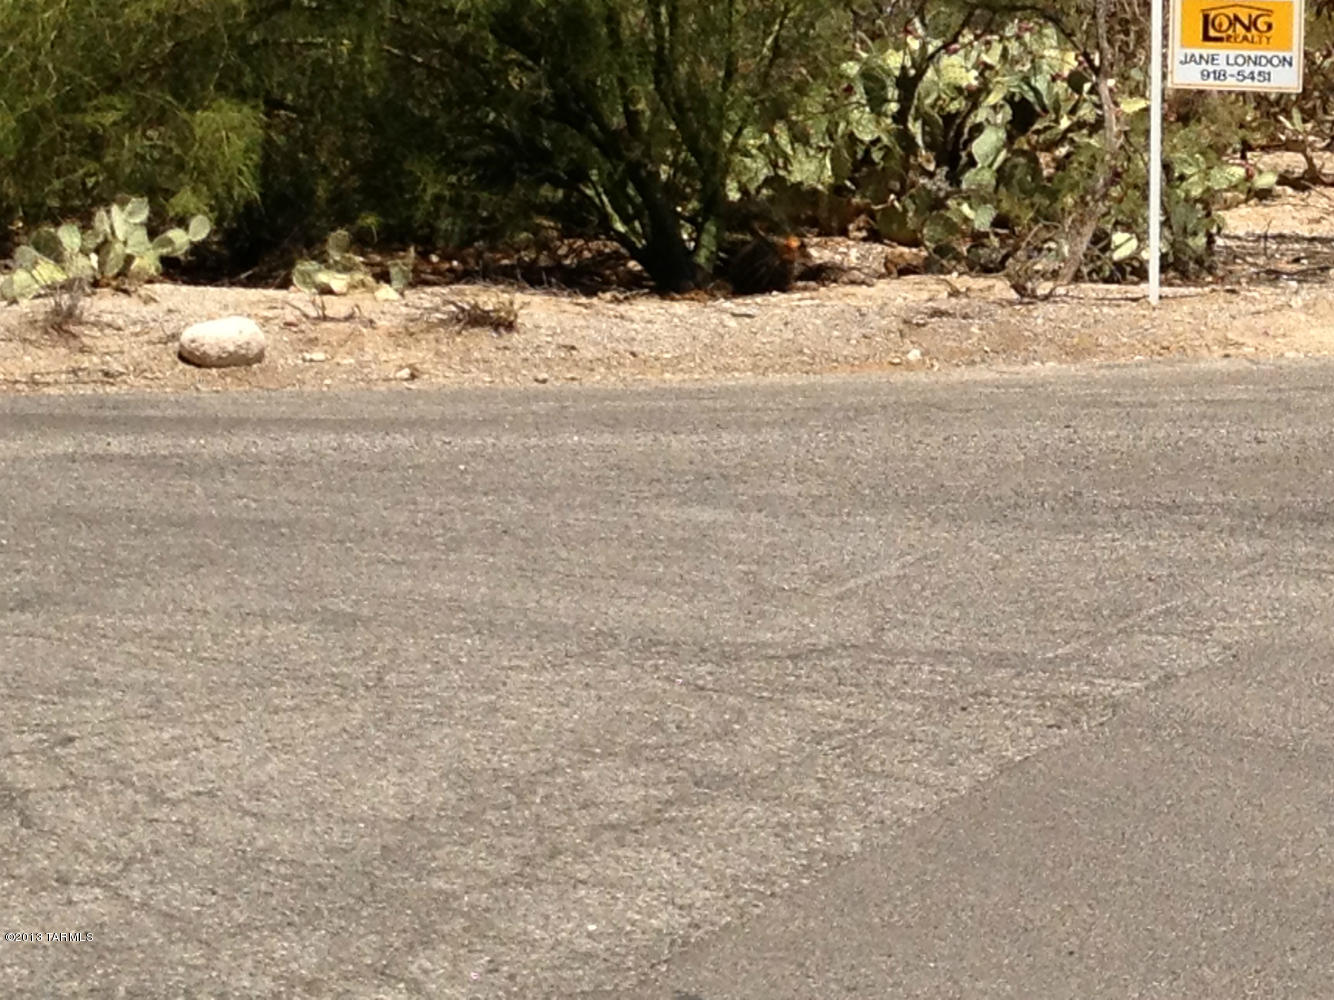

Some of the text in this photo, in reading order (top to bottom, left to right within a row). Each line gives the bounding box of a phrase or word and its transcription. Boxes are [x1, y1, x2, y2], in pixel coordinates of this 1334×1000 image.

[1201, 13, 1273, 43] LONG
[1225, 33, 1272, 45] REALTY
[1179, 53, 1293, 68] JANE LONDON
[1200, 69, 1272, 83] 918-5451
